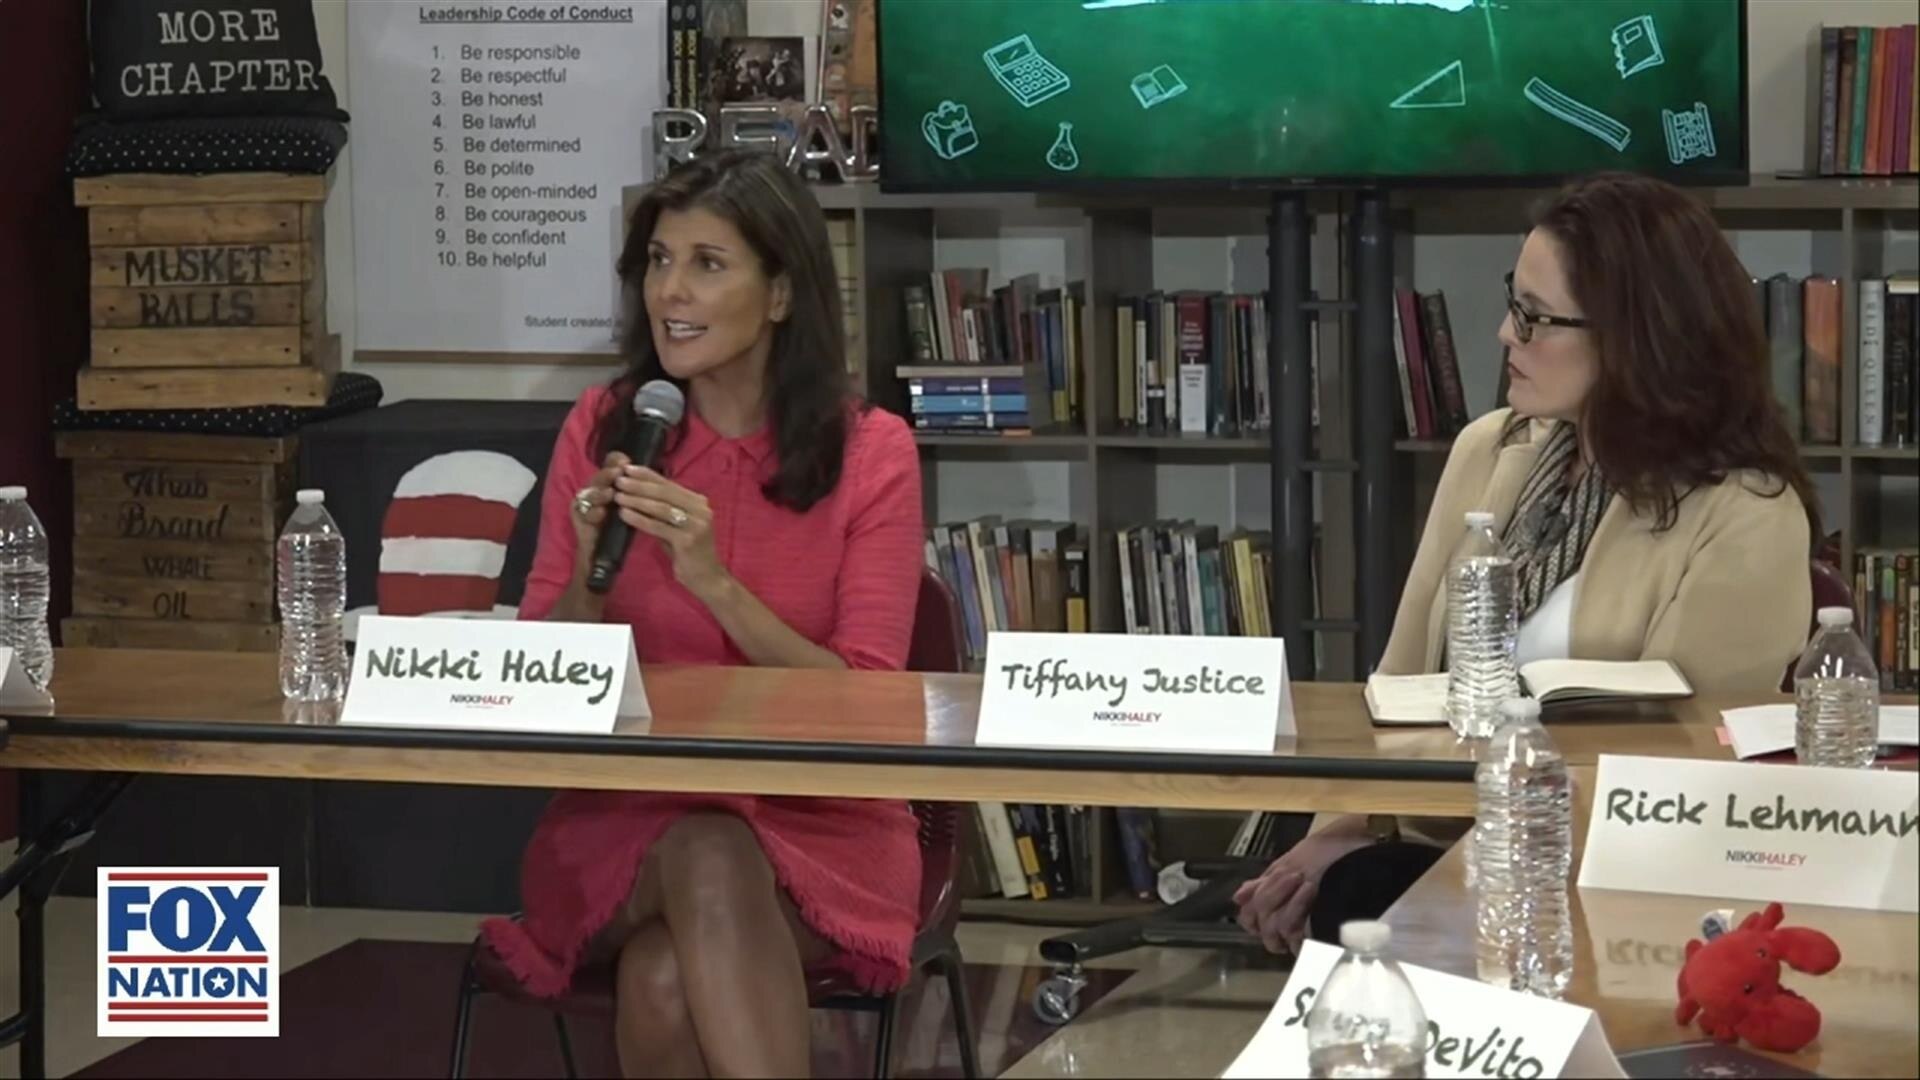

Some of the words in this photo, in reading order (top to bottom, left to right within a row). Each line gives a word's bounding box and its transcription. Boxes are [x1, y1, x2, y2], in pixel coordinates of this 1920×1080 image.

[419, 6, 503, 22] Leadership
[507, 6, 546, 20] Code
[550, 6, 565, 20] of
[569, 6, 634, 20] Conduct
[158, 9, 280, 44] MORE
[460, 44, 483, 60] Be
[487, 44, 581, 63] responsible
[121, 59, 319, 97] CHAPTER
[461, 68, 483, 83] Be
[488, 67, 567, 86] respectful
[461, 91, 484, 106] Be
[488, 91, 543, 106] honest
[462, 114, 485, 130] Be
[489, 114, 536, 130] lawful
[463, 137, 486, 153] Be
[490, 138, 581, 153] determined
[464, 160, 486, 176] Be
[491, 160, 534, 179] polite
[465, 183, 487, 199] Be
[491, 183, 597, 203] open-minded
[465, 206, 487, 222] Be
[491, 208, 587, 226] courageous
[465, 229, 487, 245] Be
[491, 229, 566, 246] confident
[125, 245, 272, 287] MUSKET
[466, 251, 488, 267] Be
[492, 251, 547, 270] helpful
[138, 289, 256, 327] BALLS
[524, 314, 568, 328] Student
[570, 316, 612, 328] created
[119, 501, 229, 540] Brand
[143, 555, 216, 581] WHALE
[153, 590, 192, 620] OIL
[366, 646, 482, 681] Nikki
[500, 648, 613, 705] Haley
[1001, 658, 1128, 707] Tiffany
[1142, 665, 1265, 695] Justice
[1605, 787, 1708, 826] Rick
[1725, 792, 1919, 838] Lehmann
